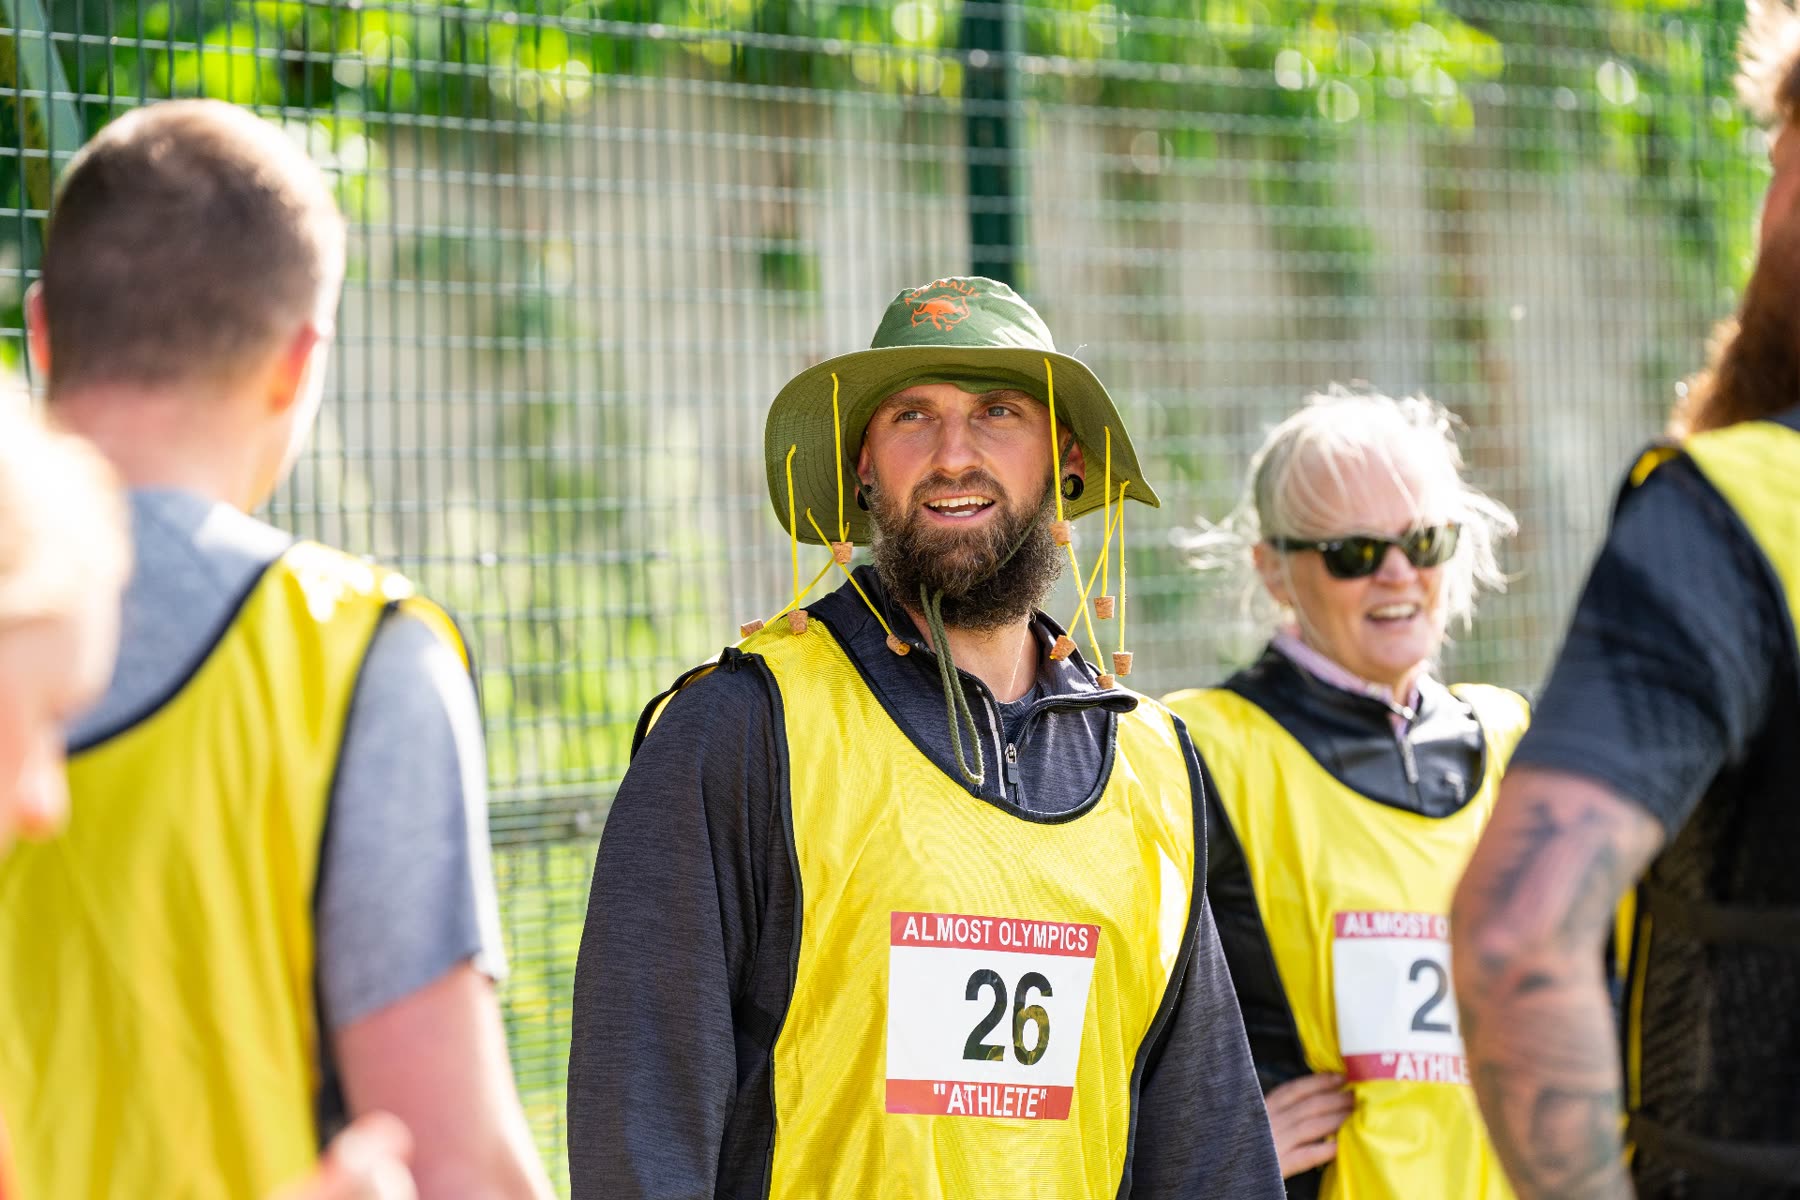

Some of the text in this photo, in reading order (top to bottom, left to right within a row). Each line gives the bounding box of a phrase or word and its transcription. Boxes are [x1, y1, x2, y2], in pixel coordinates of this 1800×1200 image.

[902, 915, 1090, 951] ALMOST OLYMPICS
[1343, 912, 1430, 938] ALMOST
[962, 968, 1053, 1066] 26
[933, 1083, 1048, 1118] "ATHLETE"
